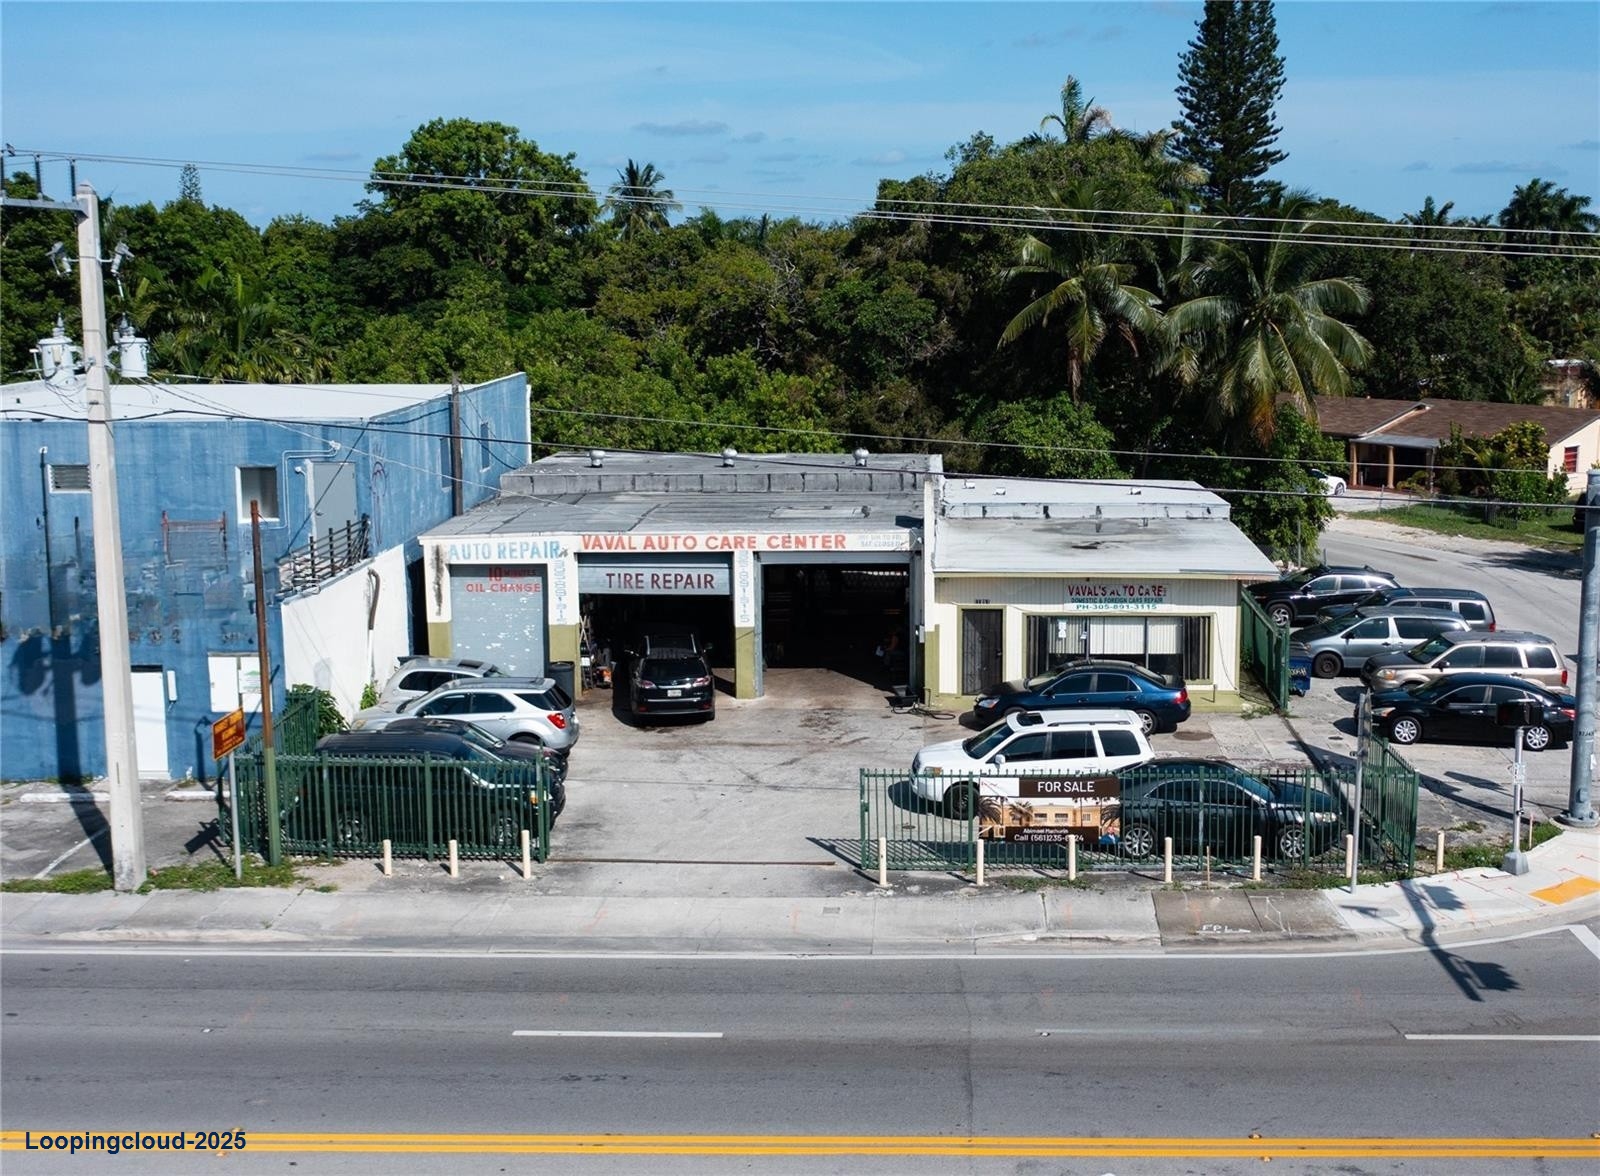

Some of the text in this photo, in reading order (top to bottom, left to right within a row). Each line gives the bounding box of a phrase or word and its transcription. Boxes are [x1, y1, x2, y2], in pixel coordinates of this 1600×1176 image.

[582, 534, 847, 550] VAVAL AUTO CARE CENTER
[449, 540, 560, 560] AUTO REPAIR
[489, 567, 502, 581] 10
[606, 573, 715, 589] TIRE REPAIR
[466, 583, 541, 592] OIL CHANGE
[1068, 585, 1107, 596] VAVAL'S
[1138, 585, 1163, 596] CARE
[1038, 781, 1095, 792] FOR SALE
